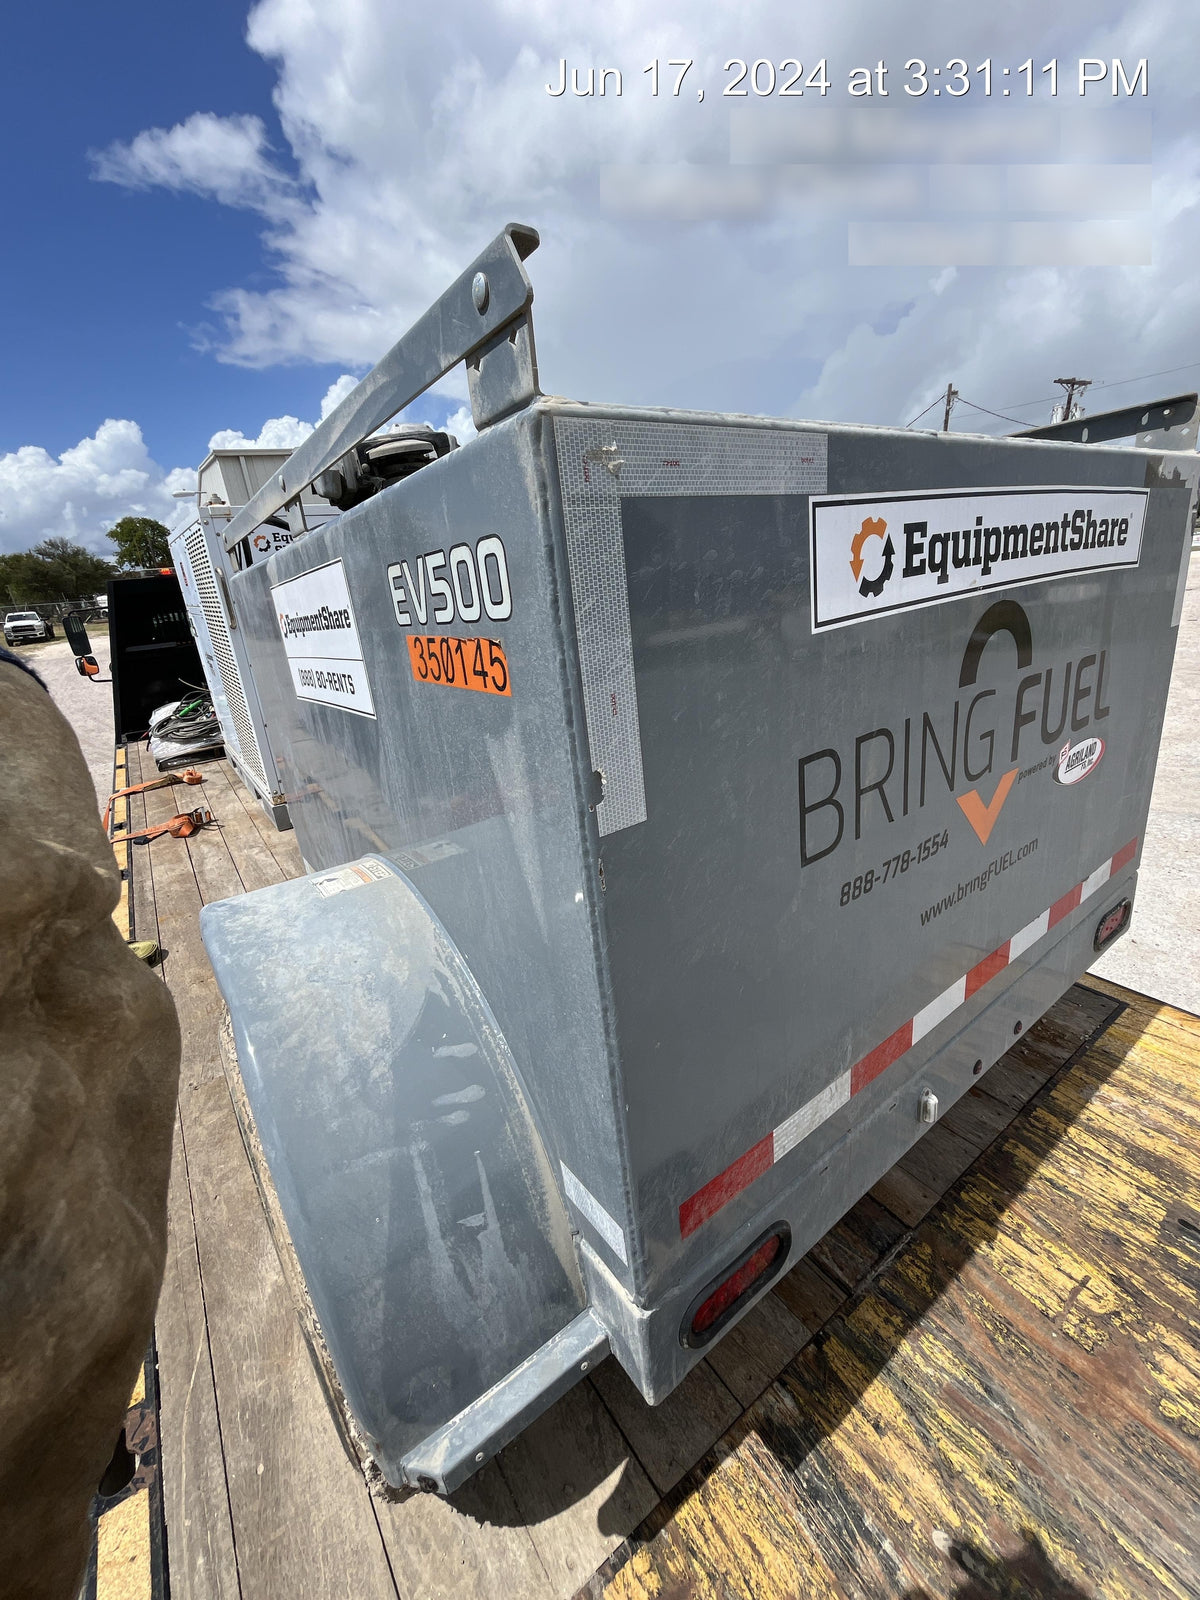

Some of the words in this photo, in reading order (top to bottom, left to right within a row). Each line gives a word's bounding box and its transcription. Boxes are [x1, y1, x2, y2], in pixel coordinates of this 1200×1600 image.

[387, 533, 513, 626] EV500
[902, 510, 1129, 585] EquipmentShare
[285, 605, 351, 638] EquipmentShare
[298, 668, 317, 689] (888)
[315, 670, 356, 695] 80-RENTS
[414, 636, 508, 692] 350145
[798, 689, 997, 869] BRING
[1010, 650, 1110, 763] FUEL
[1018, 756, 1048, 785] powered
[1048, 754, 1057, 767] by
[840, 829, 950, 907] 888-778-1554
[920, 838, 1039, 927] www.bringFUEL.com
